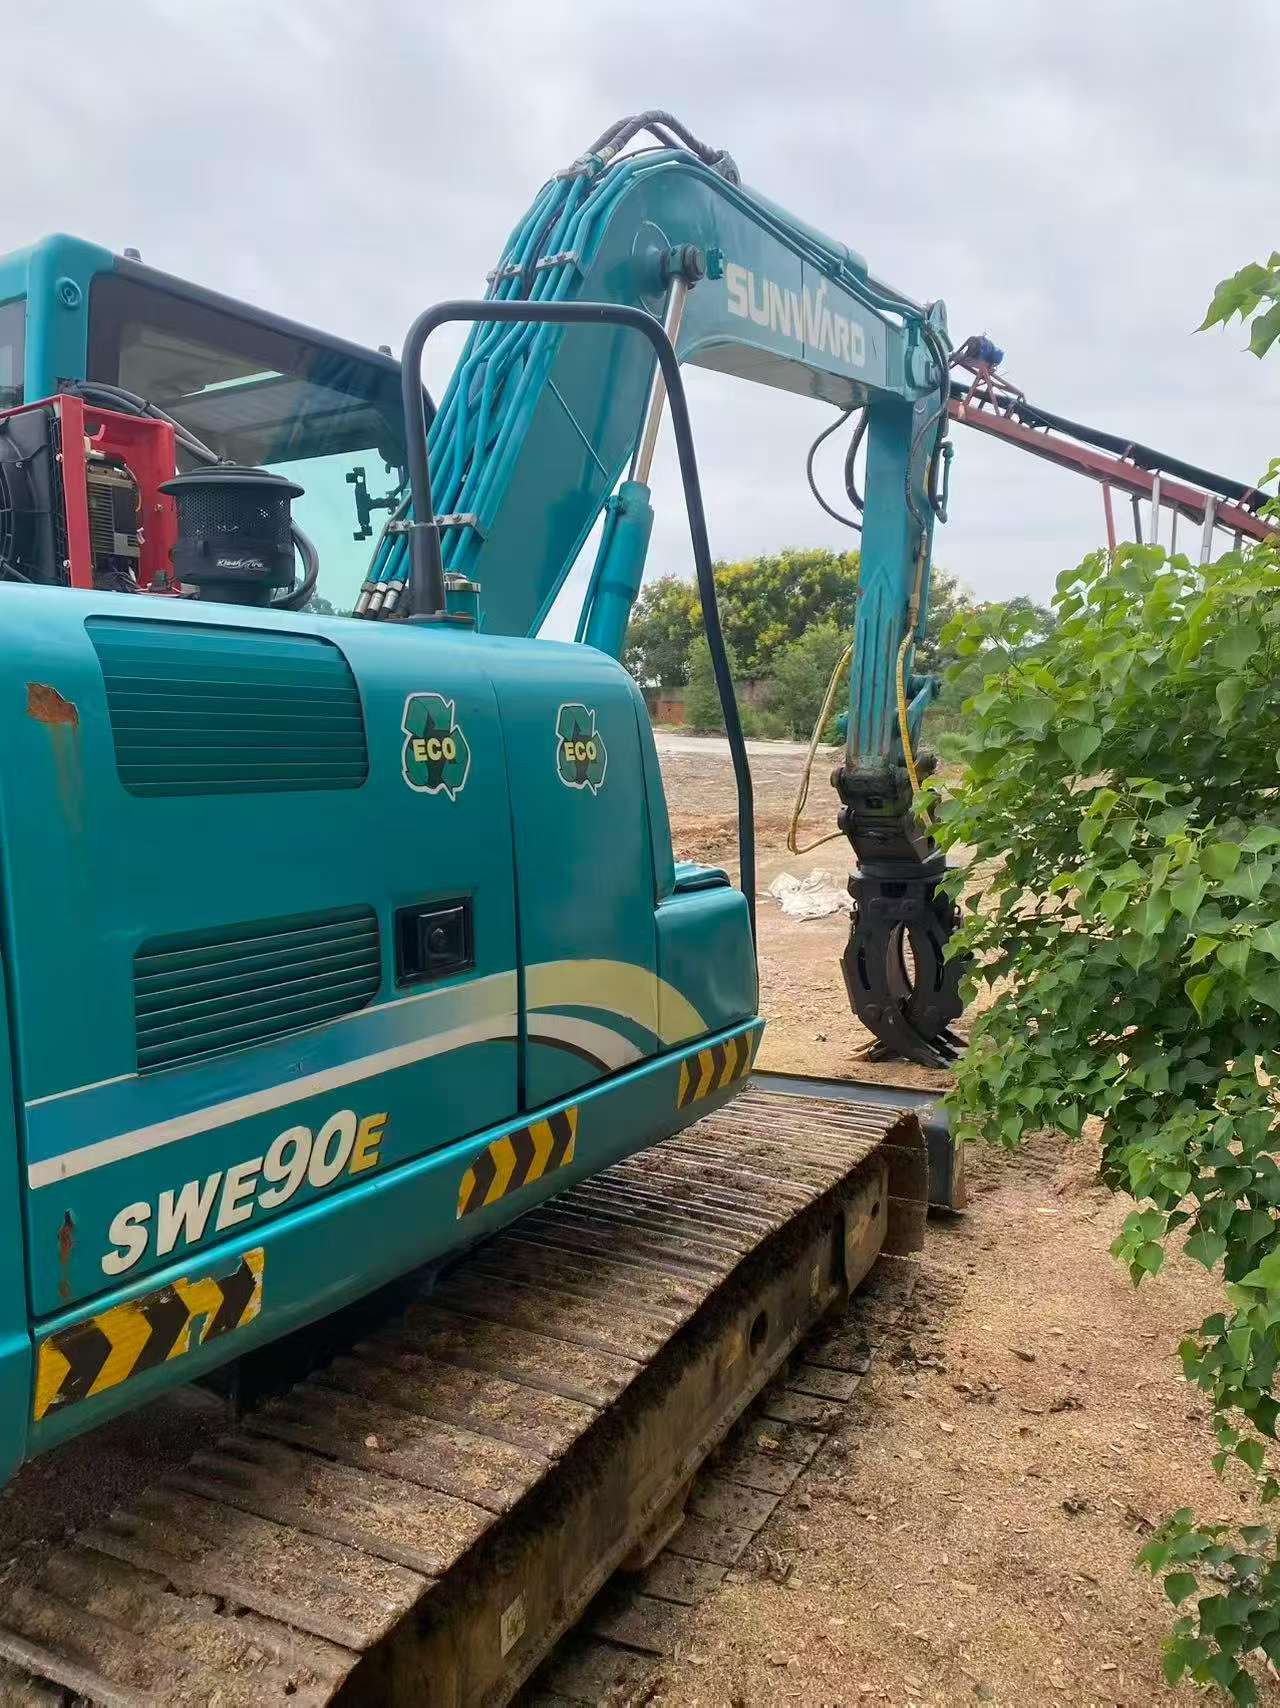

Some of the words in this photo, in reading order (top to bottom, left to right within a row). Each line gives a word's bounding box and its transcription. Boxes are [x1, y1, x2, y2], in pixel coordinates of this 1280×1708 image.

[727, 263, 865, 368] SUNWARD
[412, 737, 456, 762] ECO
[564, 741, 597, 761] ECO
[101, 1109, 388, 1276] SWE90E
